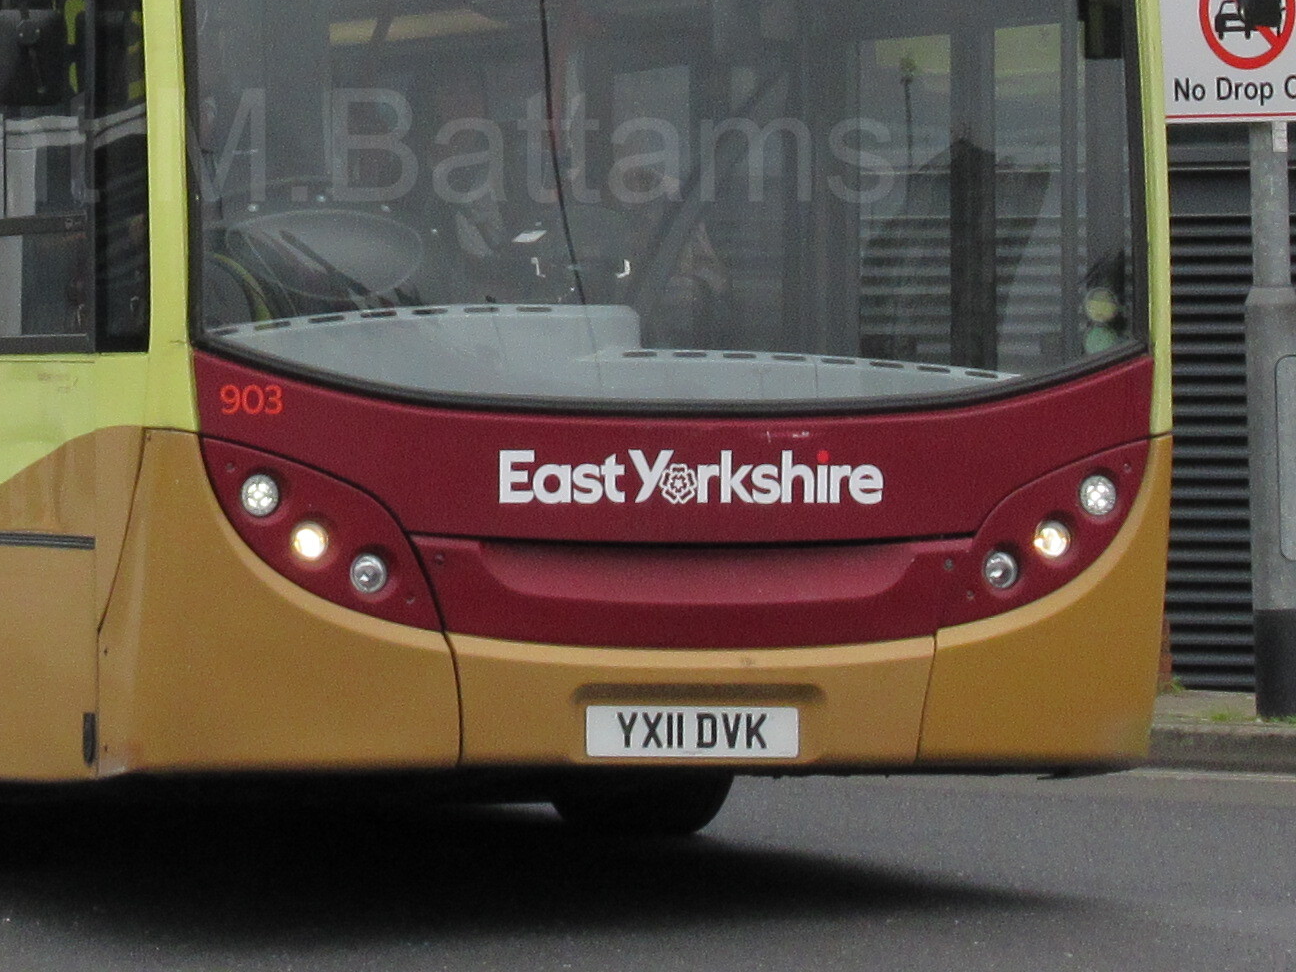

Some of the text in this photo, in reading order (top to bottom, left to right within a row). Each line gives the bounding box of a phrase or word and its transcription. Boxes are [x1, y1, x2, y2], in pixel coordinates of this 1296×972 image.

[1174, 77, 1206, 102] No
[1216, 76, 1274, 106] Drop
[220, 384, 283, 415] 903
[499, 449, 625, 505] East
[617, 712, 767, 749] YX11 DVK
